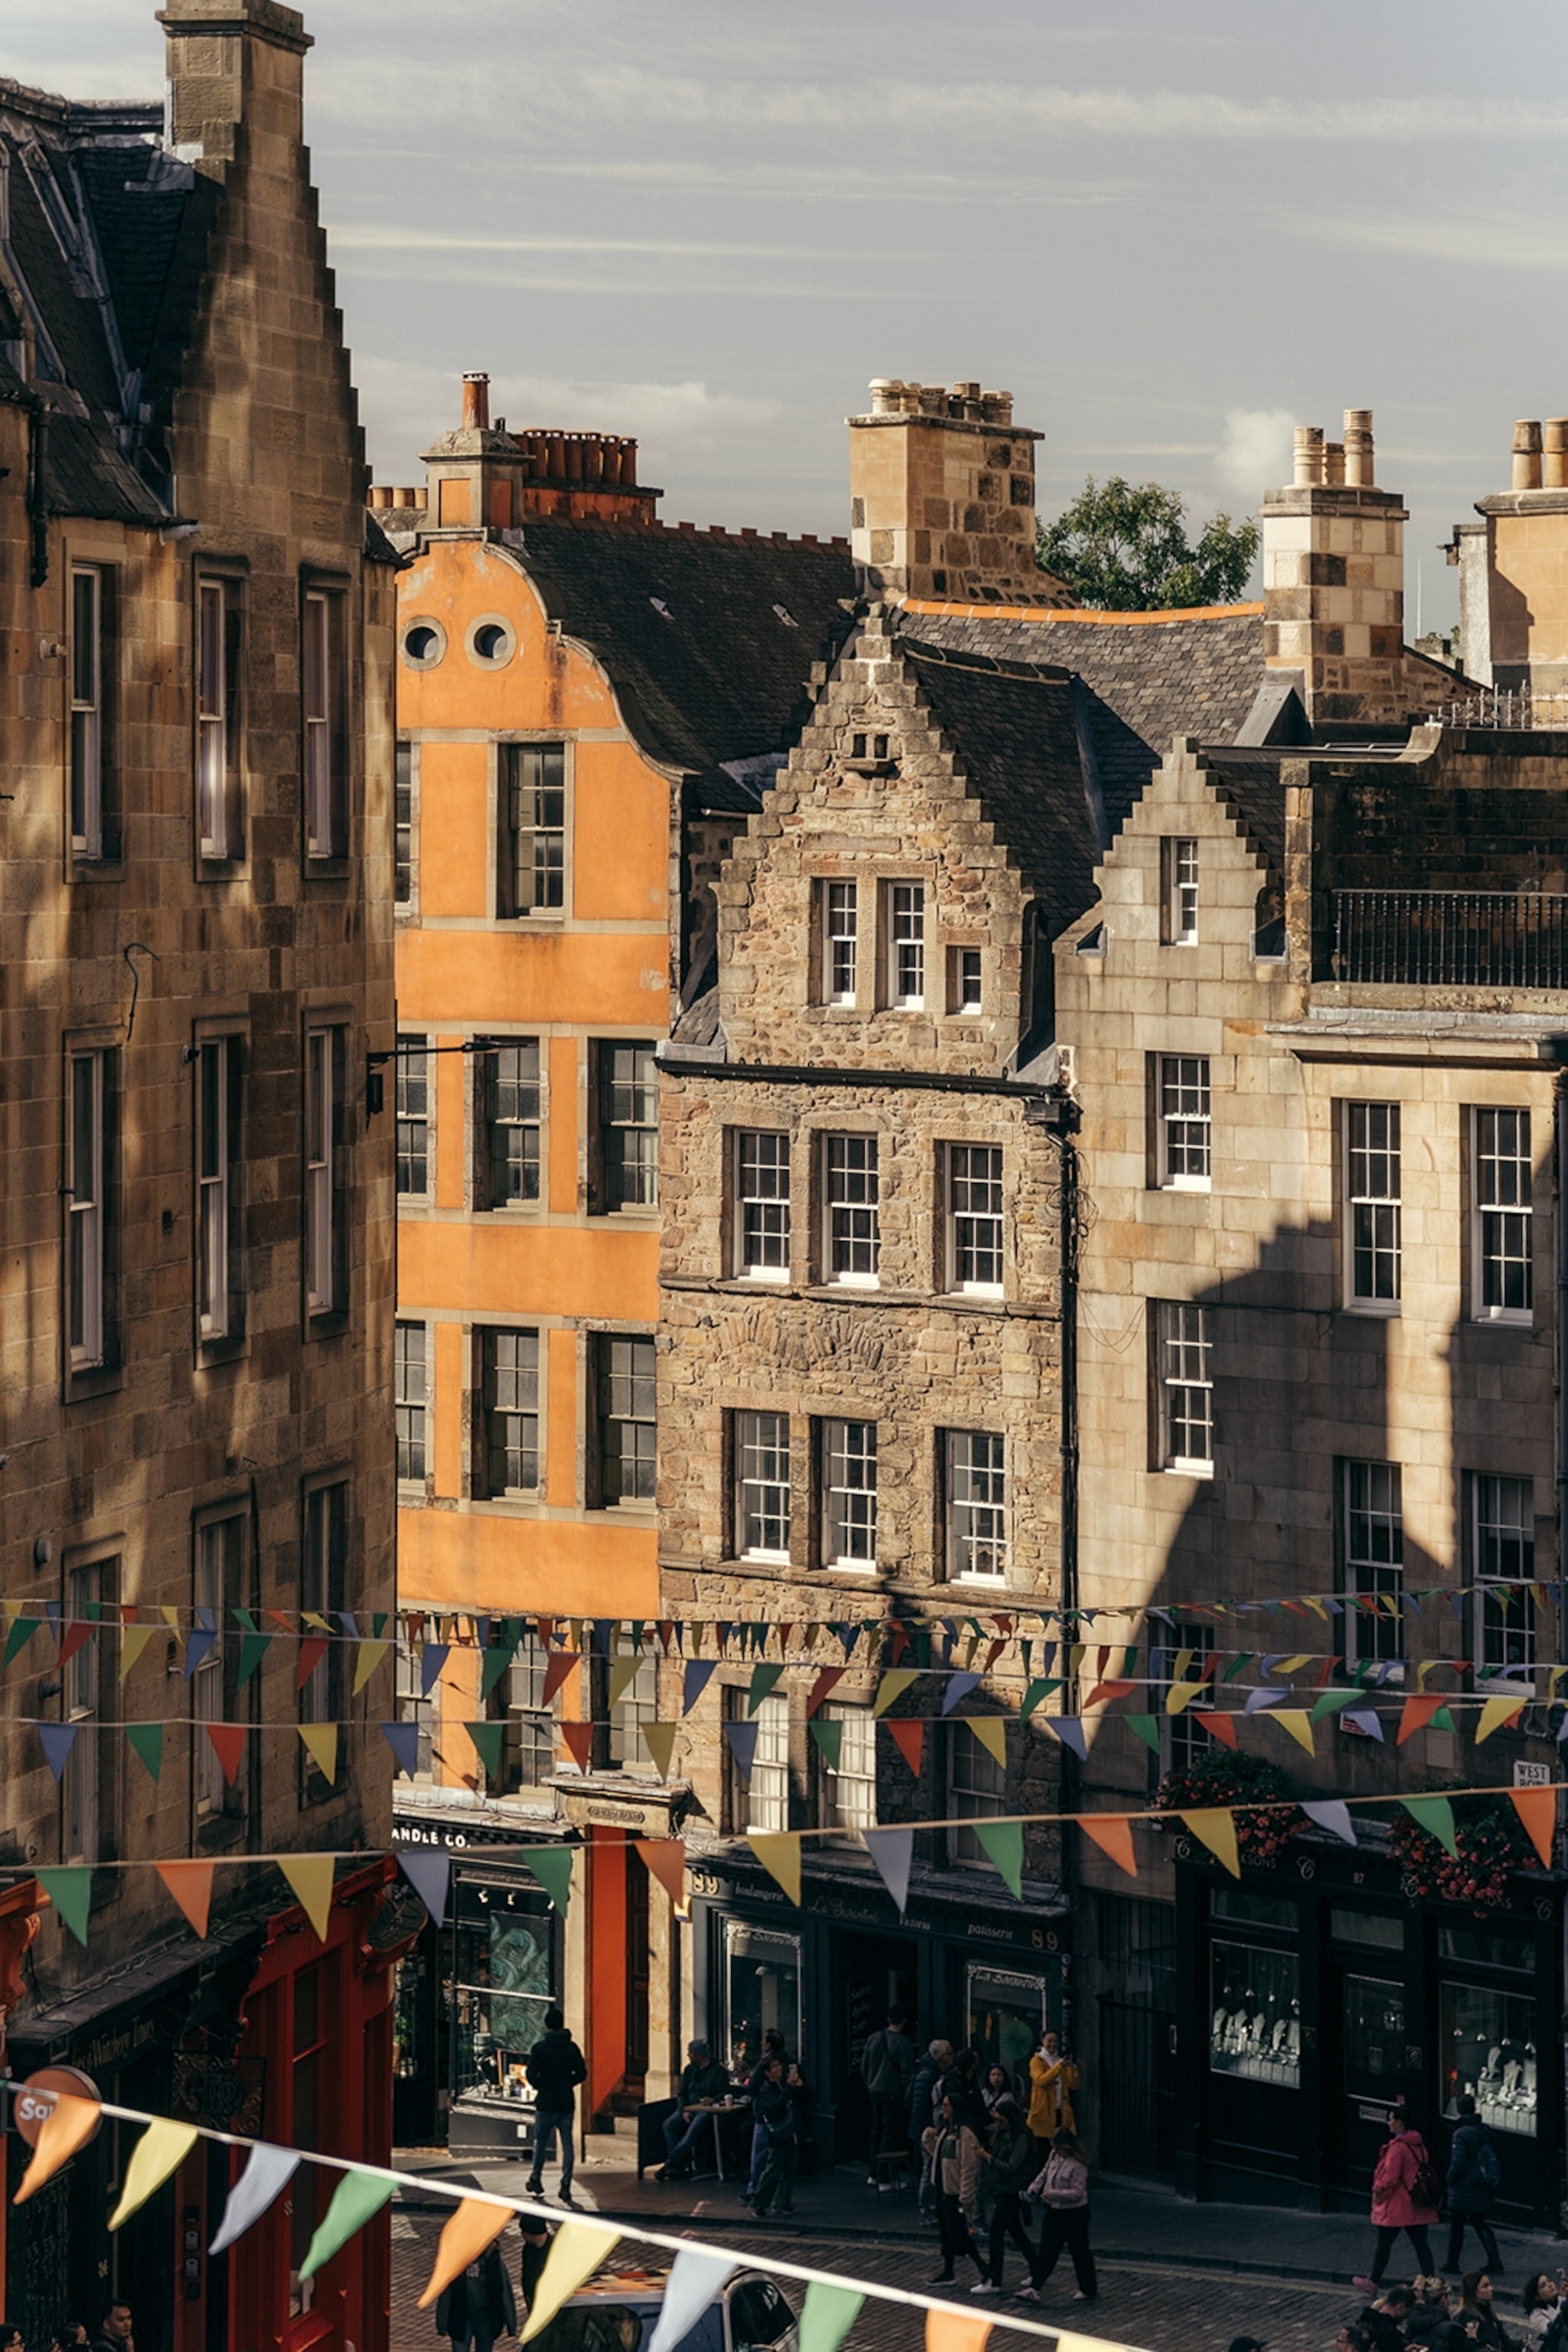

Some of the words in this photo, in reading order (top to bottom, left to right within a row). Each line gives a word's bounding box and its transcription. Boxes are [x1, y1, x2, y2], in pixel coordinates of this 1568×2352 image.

[1517, 1763, 1547, 1779] WEST
[391, 1828, 439, 1845] ANDLE
[445, 1834, 471, 1849] CO.
[693, 1873, 719, 1895] 89
[1353, 1872, 1364, 1884] 87
[735, 1881, 785, 1902] boulangerie
[1031, 1929, 1059, 1952] 89
